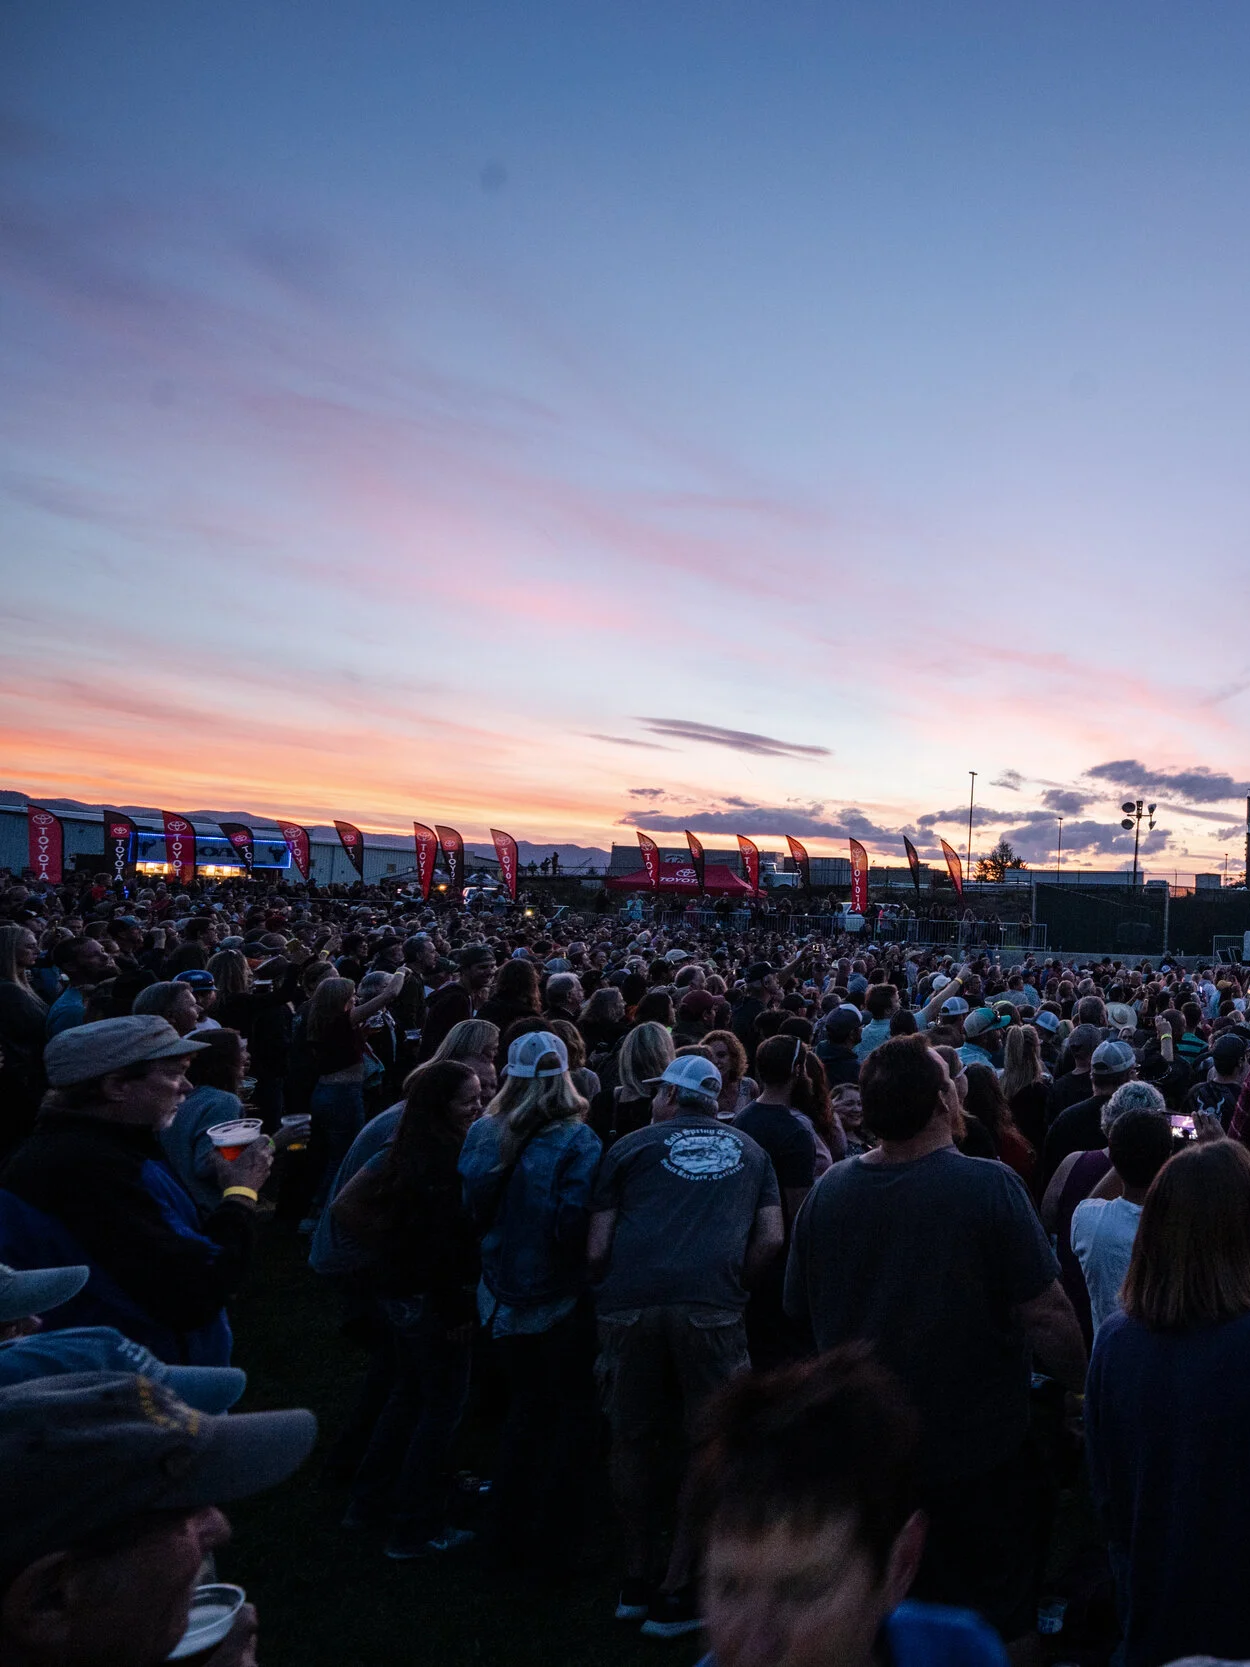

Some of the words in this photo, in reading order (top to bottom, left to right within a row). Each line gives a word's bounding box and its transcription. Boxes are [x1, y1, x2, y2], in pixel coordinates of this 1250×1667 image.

[38, 827, 49, 880] TOYOTA
[114, 839, 125, 881] TOYOTA
[172, 834, 183, 876] TOYOT
